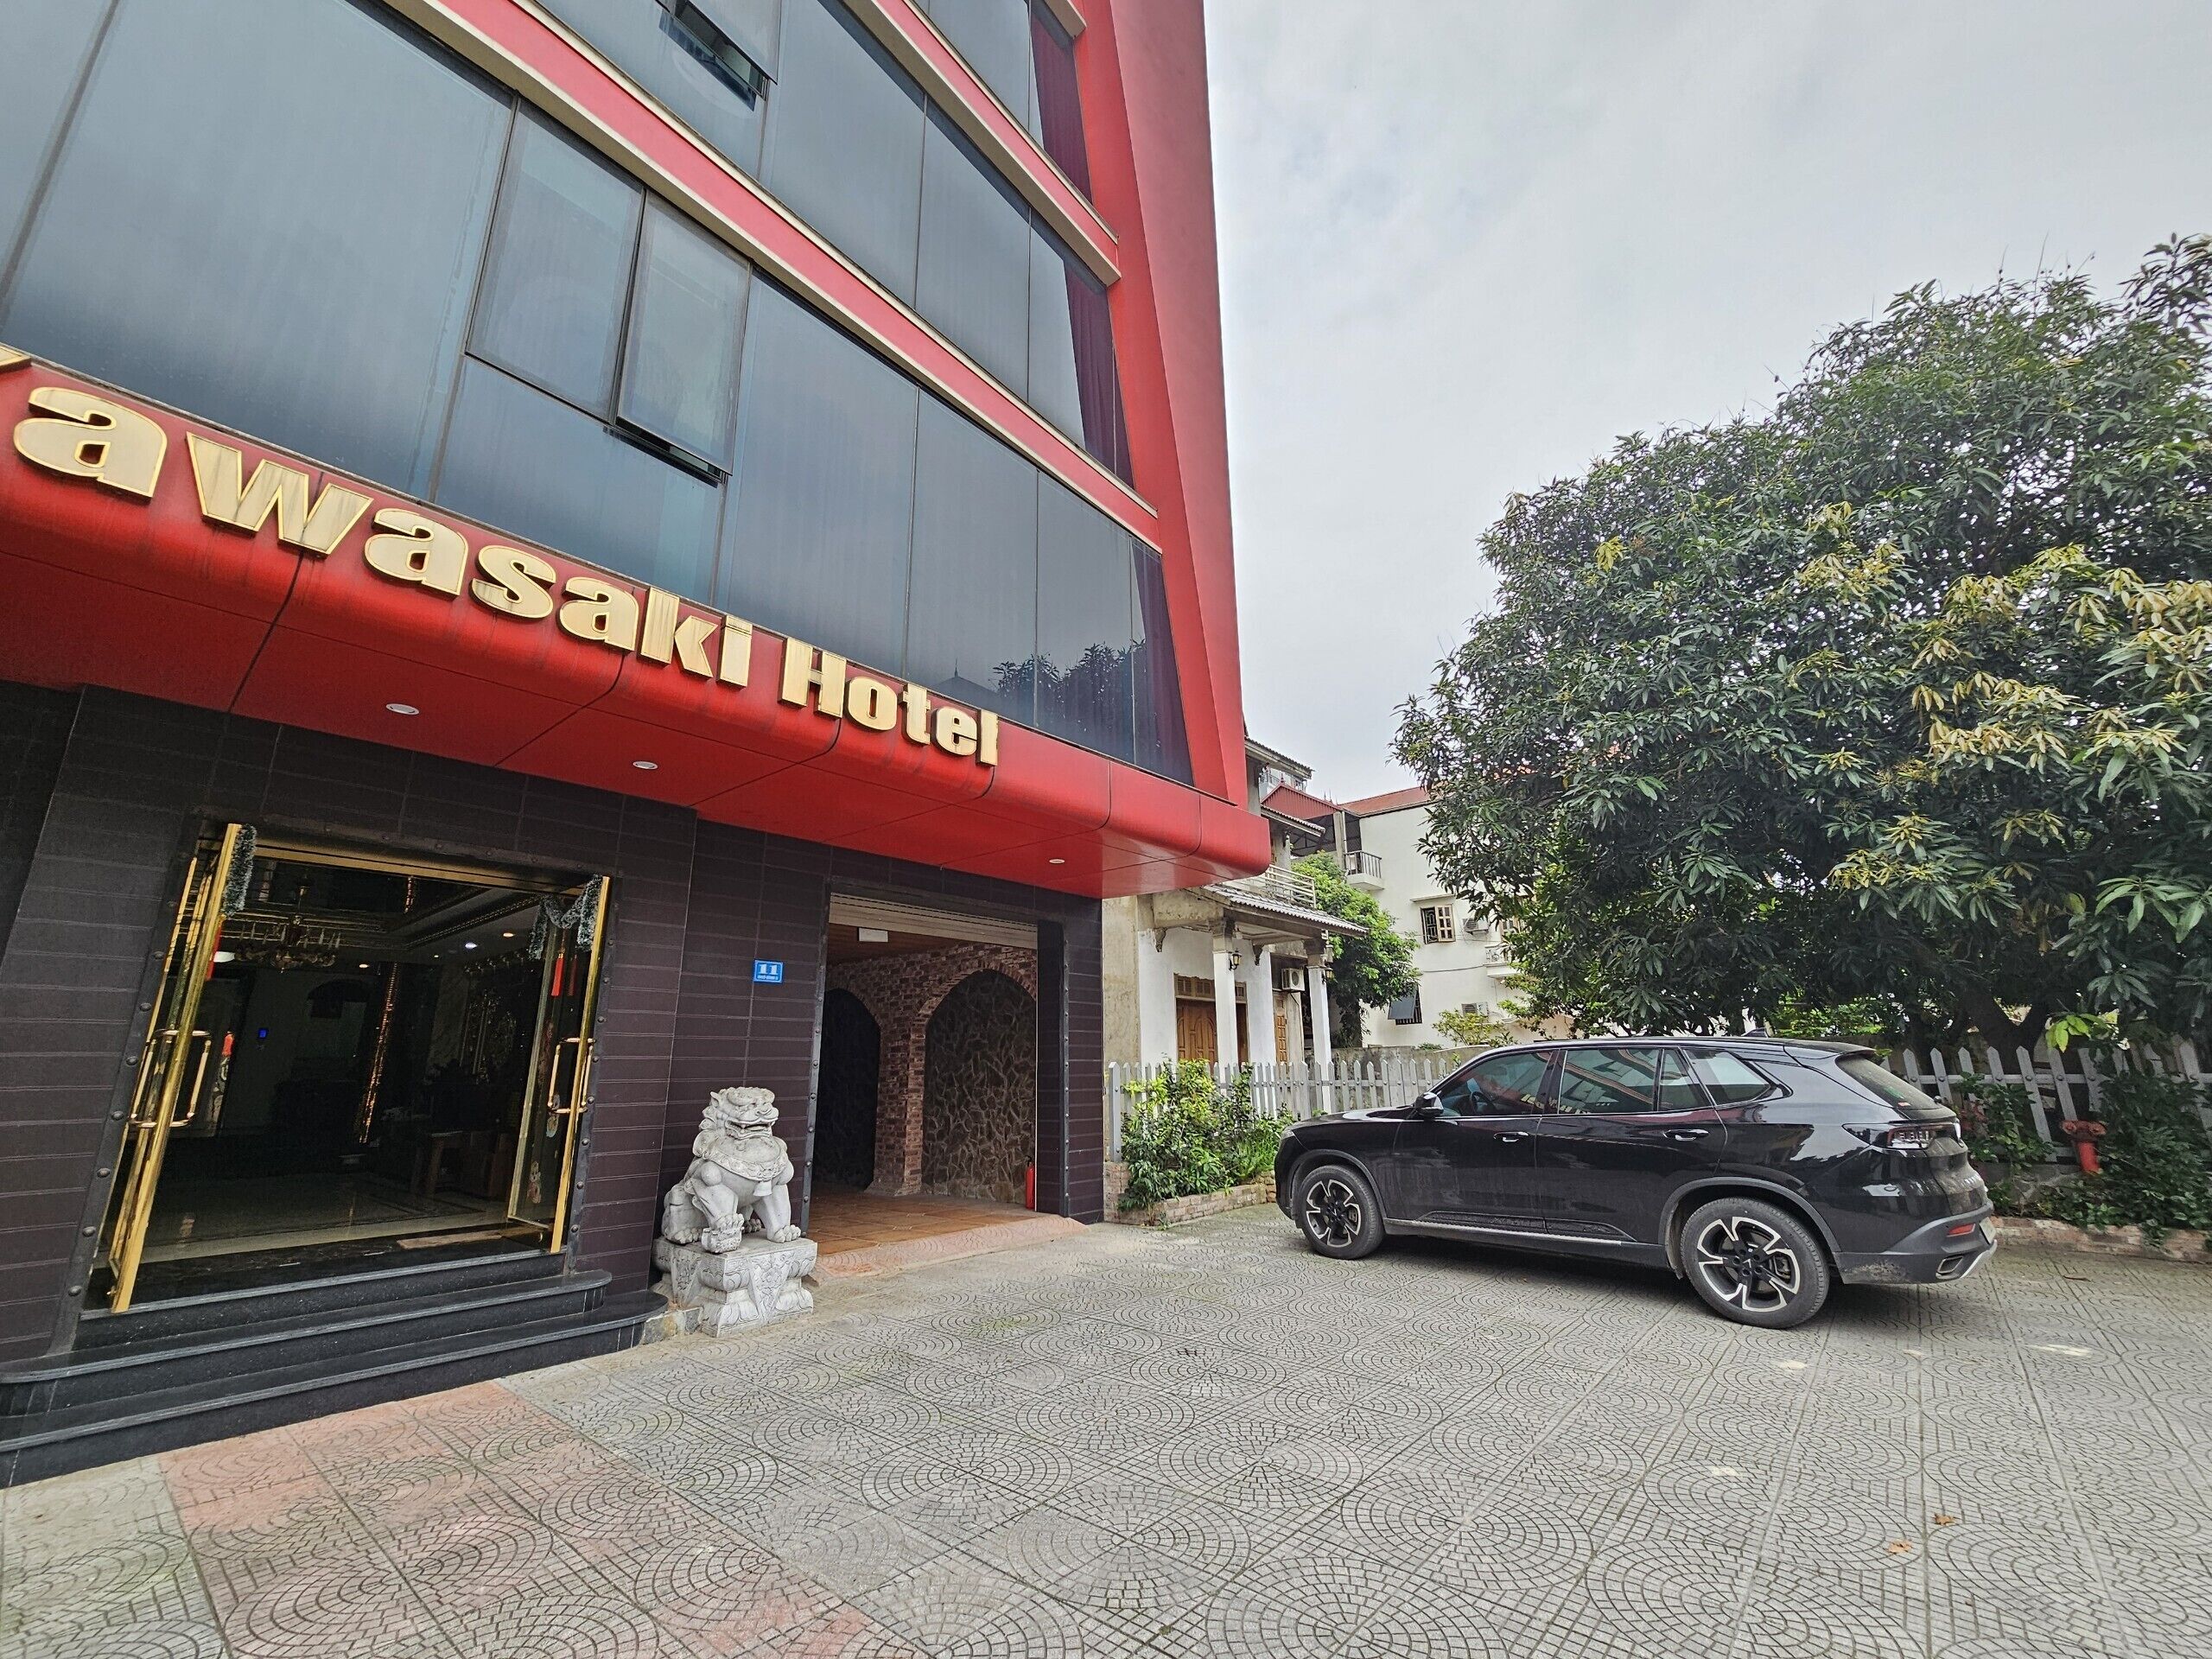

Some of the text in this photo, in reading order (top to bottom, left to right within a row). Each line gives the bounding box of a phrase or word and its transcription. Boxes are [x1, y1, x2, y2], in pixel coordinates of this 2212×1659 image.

[0, 346, 999, 766] awasaki Hotel
[759, 963, 779, 976] 11
